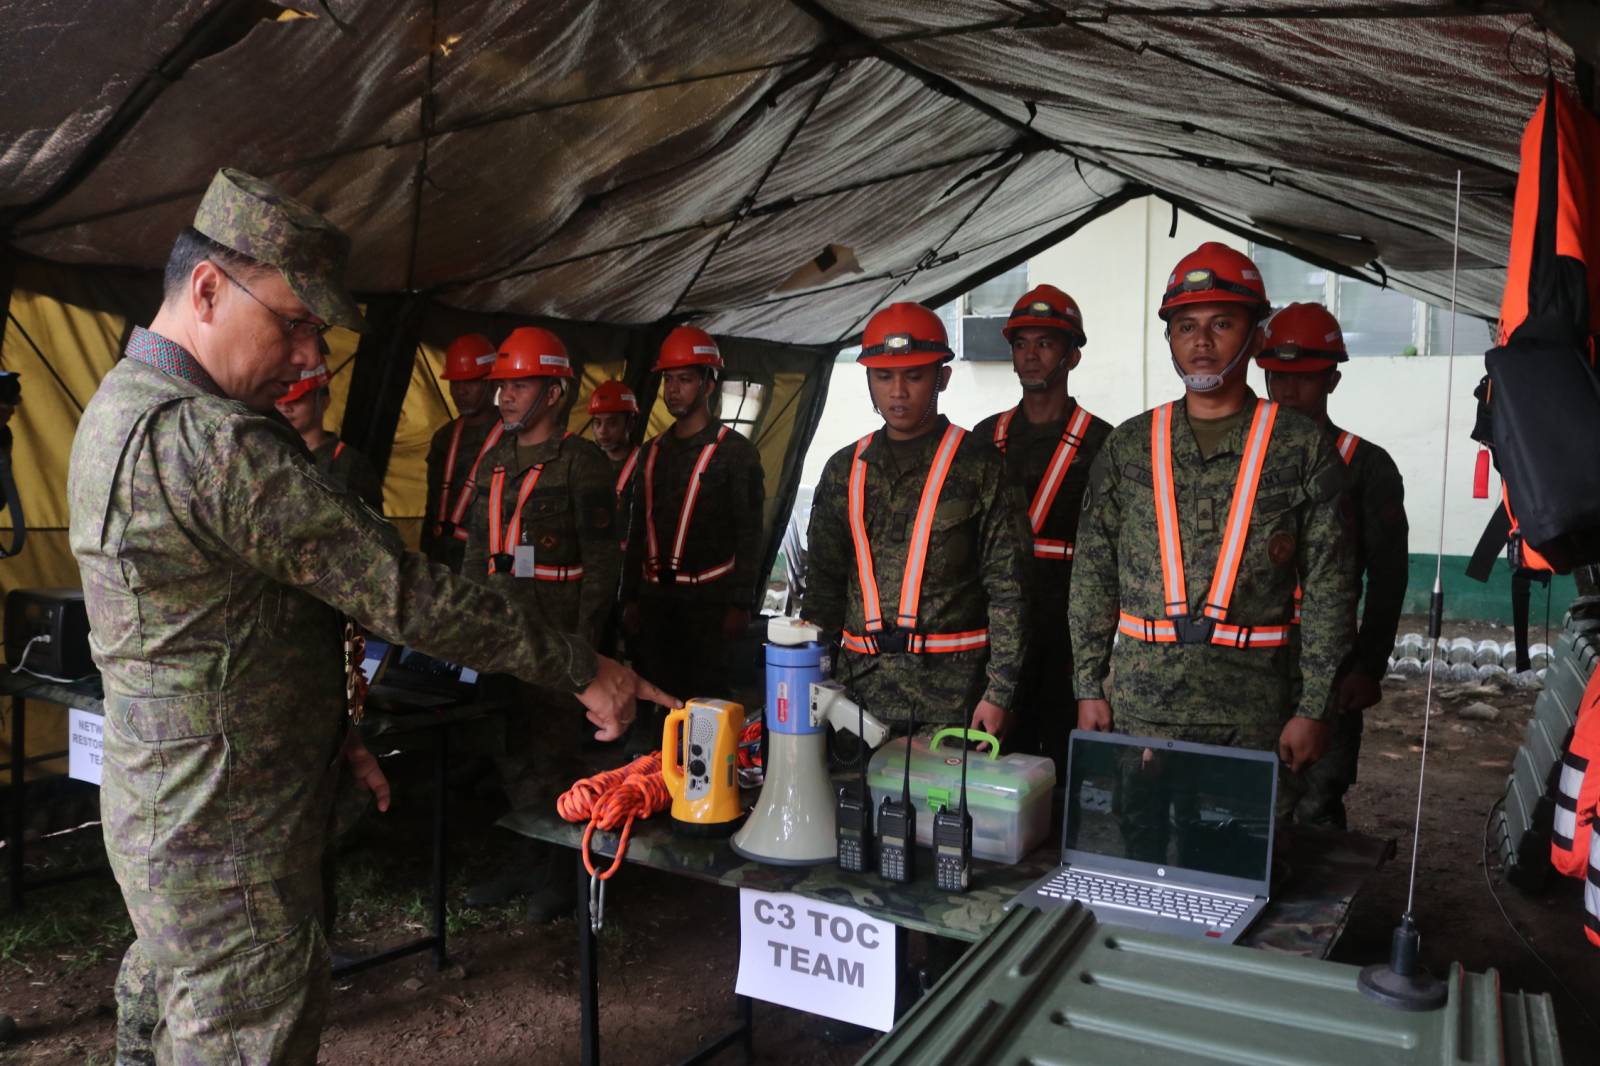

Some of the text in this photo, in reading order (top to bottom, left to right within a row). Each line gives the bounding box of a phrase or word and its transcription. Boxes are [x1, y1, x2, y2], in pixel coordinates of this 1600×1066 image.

[78, 720, 103, 734] NETW
[72, 733, 103, 749] RESTOR
[89, 752, 103, 765] TE
[754, 899, 880, 949] C3 TOC
[768, 940, 864, 988] TEAM
